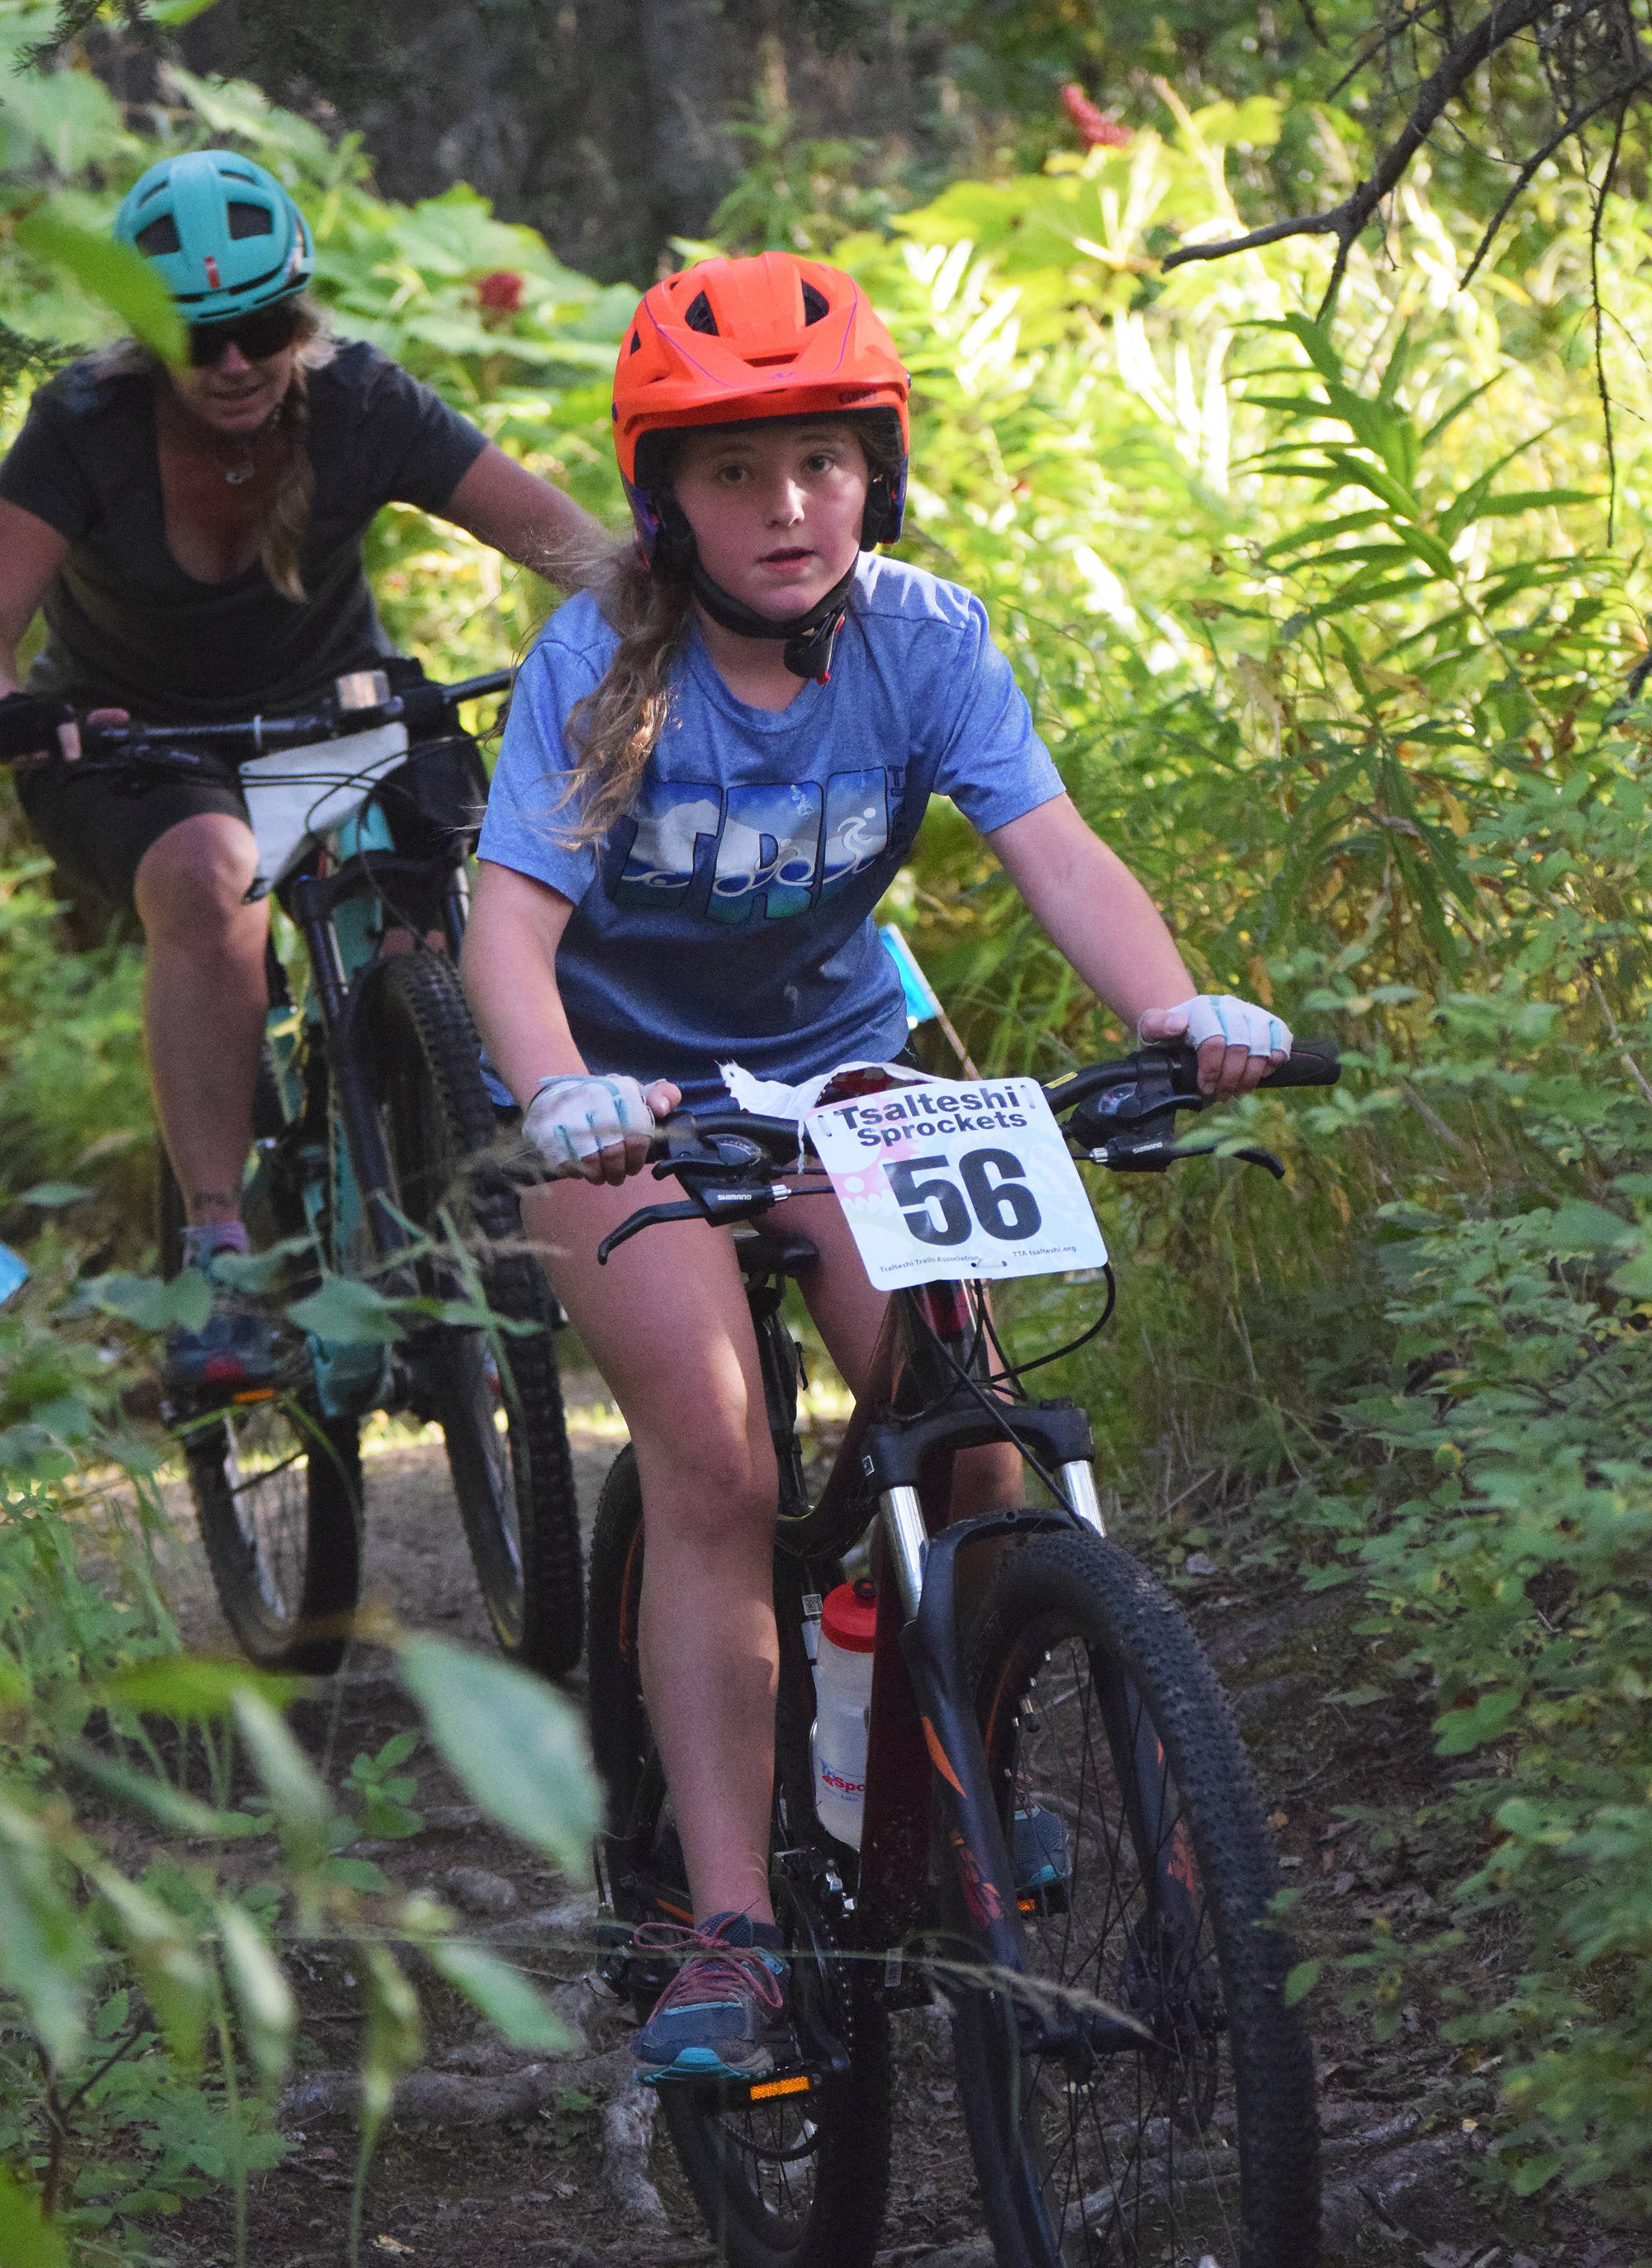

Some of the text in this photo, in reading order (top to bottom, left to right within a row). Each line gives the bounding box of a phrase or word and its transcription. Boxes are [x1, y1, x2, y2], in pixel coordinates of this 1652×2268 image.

[834, 1085, 1021, 1131] Tsalteshi
[857, 1111, 1028, 1148] Sprockets
[882, 1148, 1042, 1246] 56
[879, 1255, 980, 1273] Tsalteshi Trails Association
[1028, 1246, 1077, 1255] tsalteshi.org
